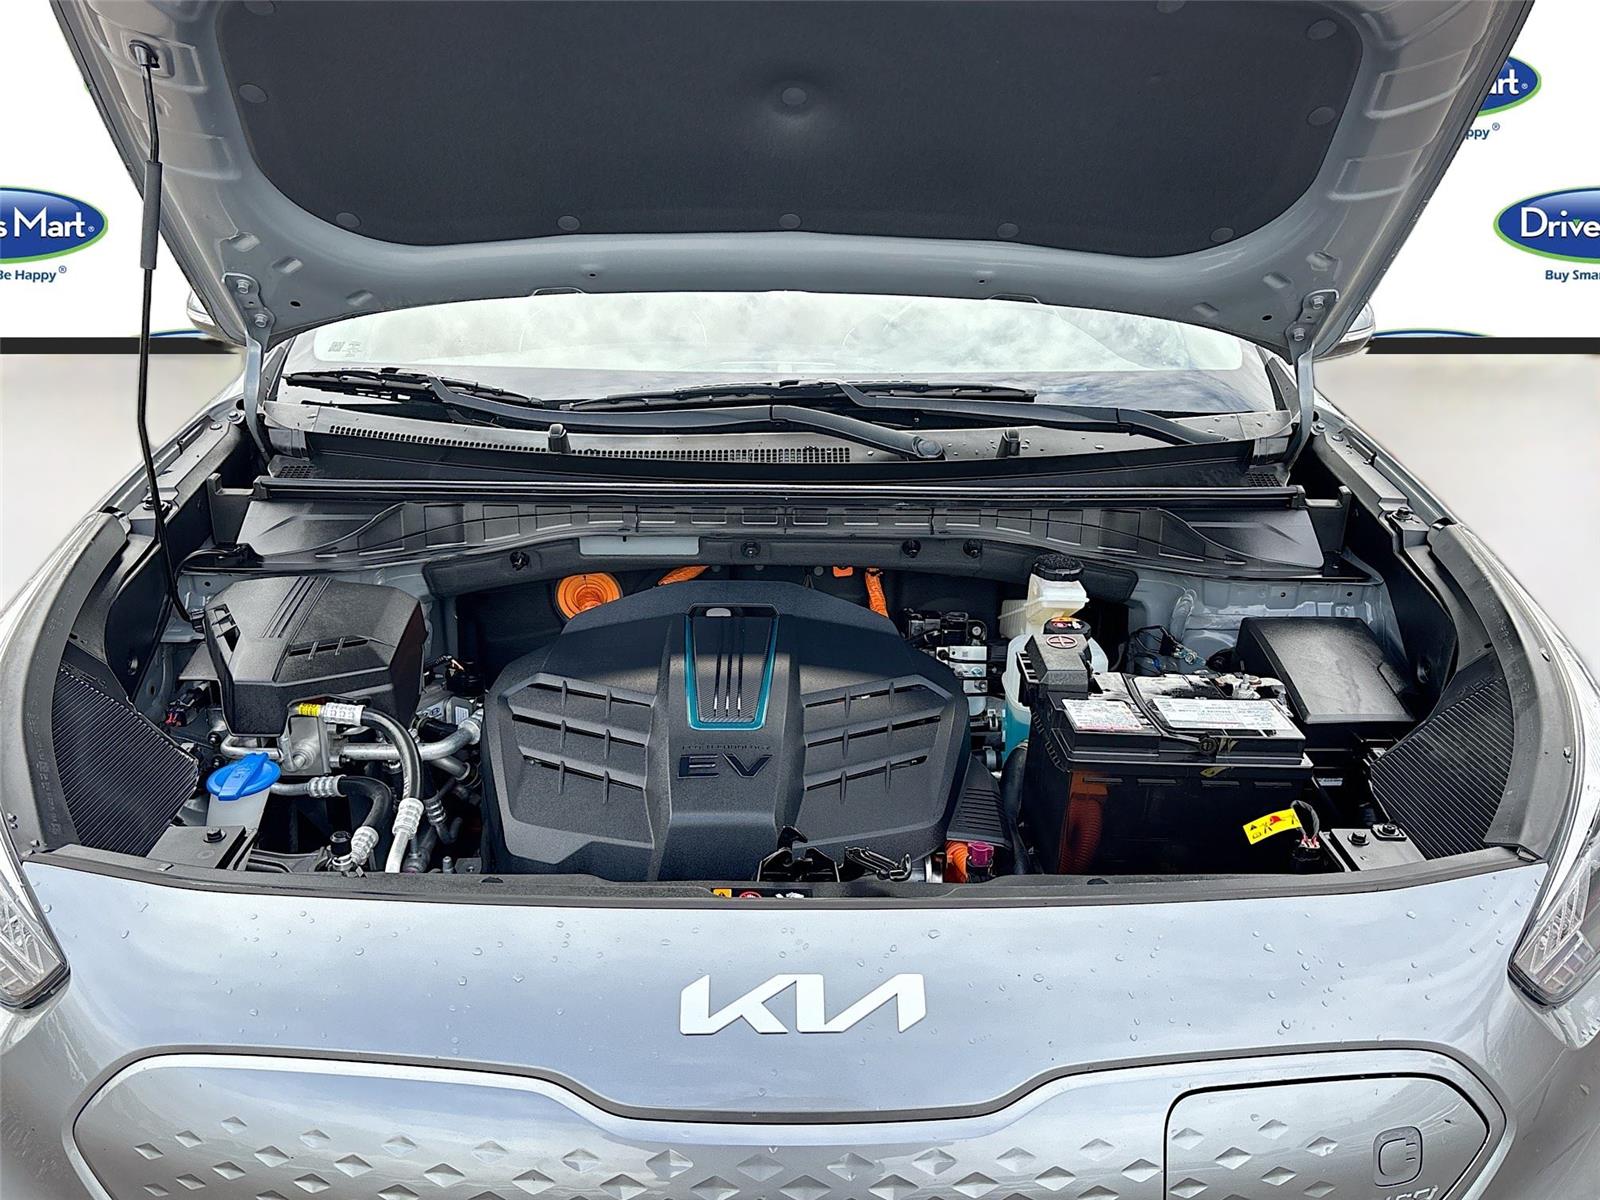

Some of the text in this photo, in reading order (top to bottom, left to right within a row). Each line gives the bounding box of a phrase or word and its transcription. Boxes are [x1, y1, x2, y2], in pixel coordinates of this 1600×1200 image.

[13, 206, 86, 238] Mart
[15, 270, 57, 283] Happy
[1545, 269, 1570, 283] Buy
[677, 752, 773, 779] EV
